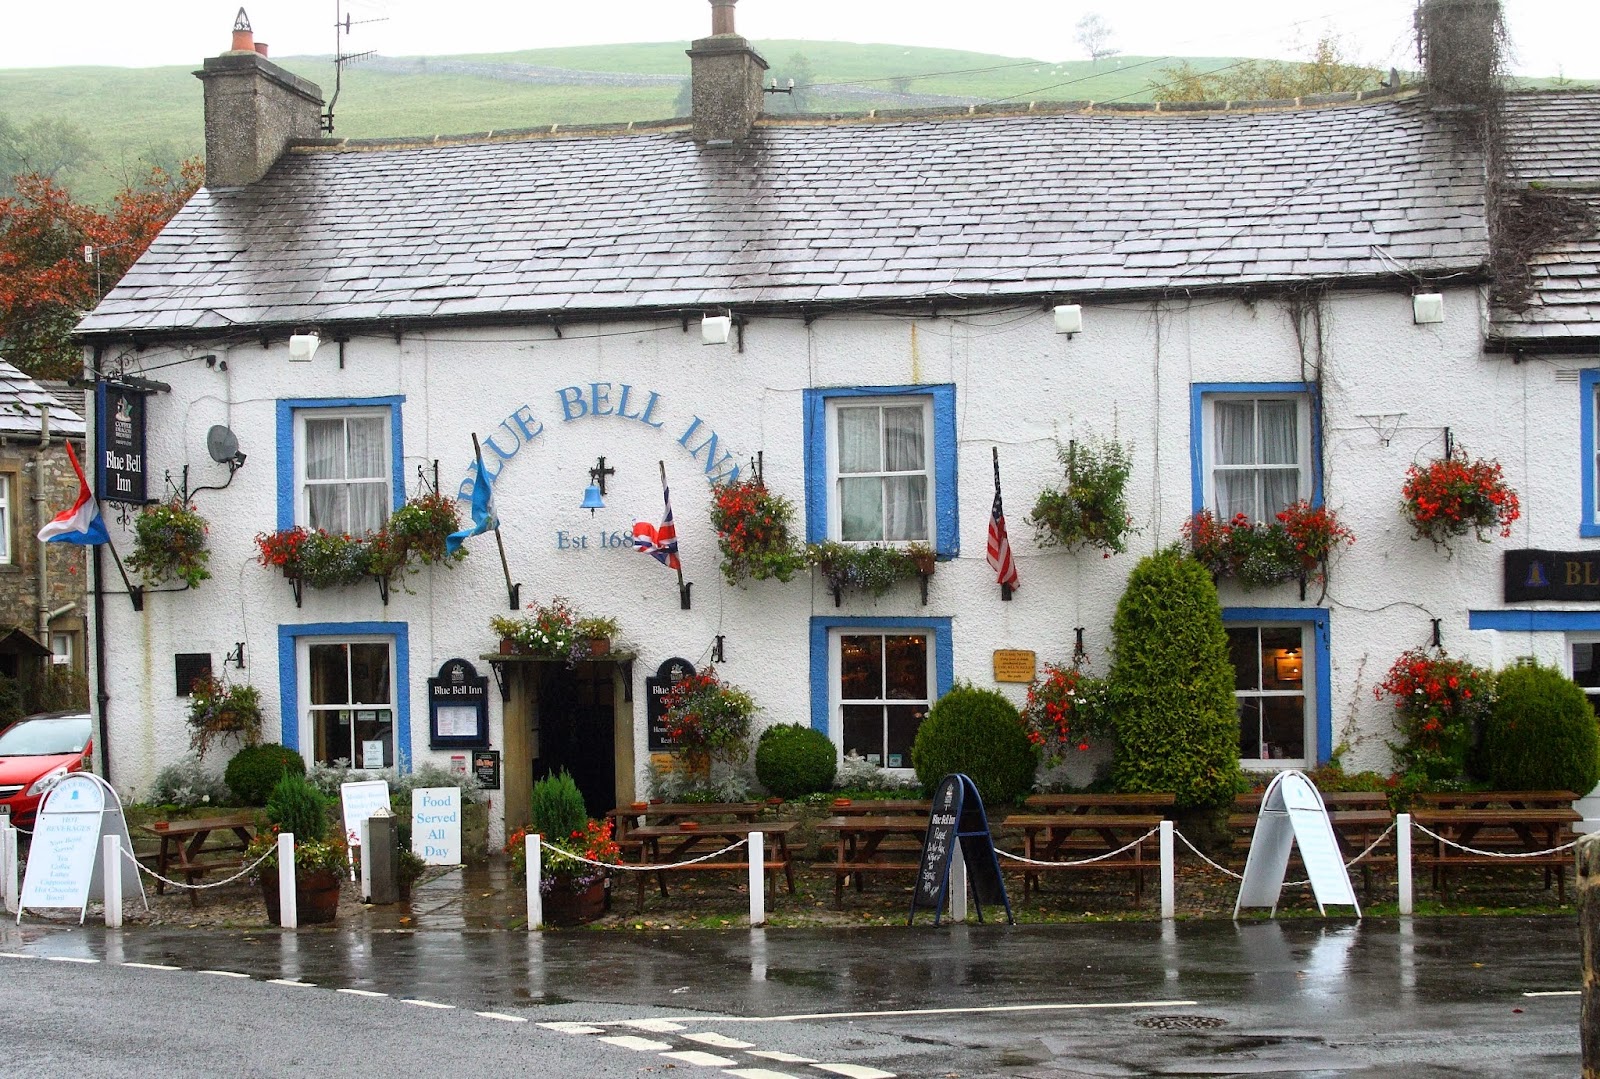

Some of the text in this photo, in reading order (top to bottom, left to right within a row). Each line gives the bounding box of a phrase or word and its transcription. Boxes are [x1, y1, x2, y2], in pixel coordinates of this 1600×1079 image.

[555, 382, 665, 428] BELL
[106, 450, 141, 472] Blue Bell
[116, 473, 132, 492] Inn
[557, 530, 634, 550] Est 168
[434, 685, 483, 695] Blue Bell Inn
[652, 685, 669, 695] Blue
[422, 796, 451, 807] Food
[416, 812, 456, 824] Served
[427, 829, 445, 840] All
[425, 846, 449, 858] Day
